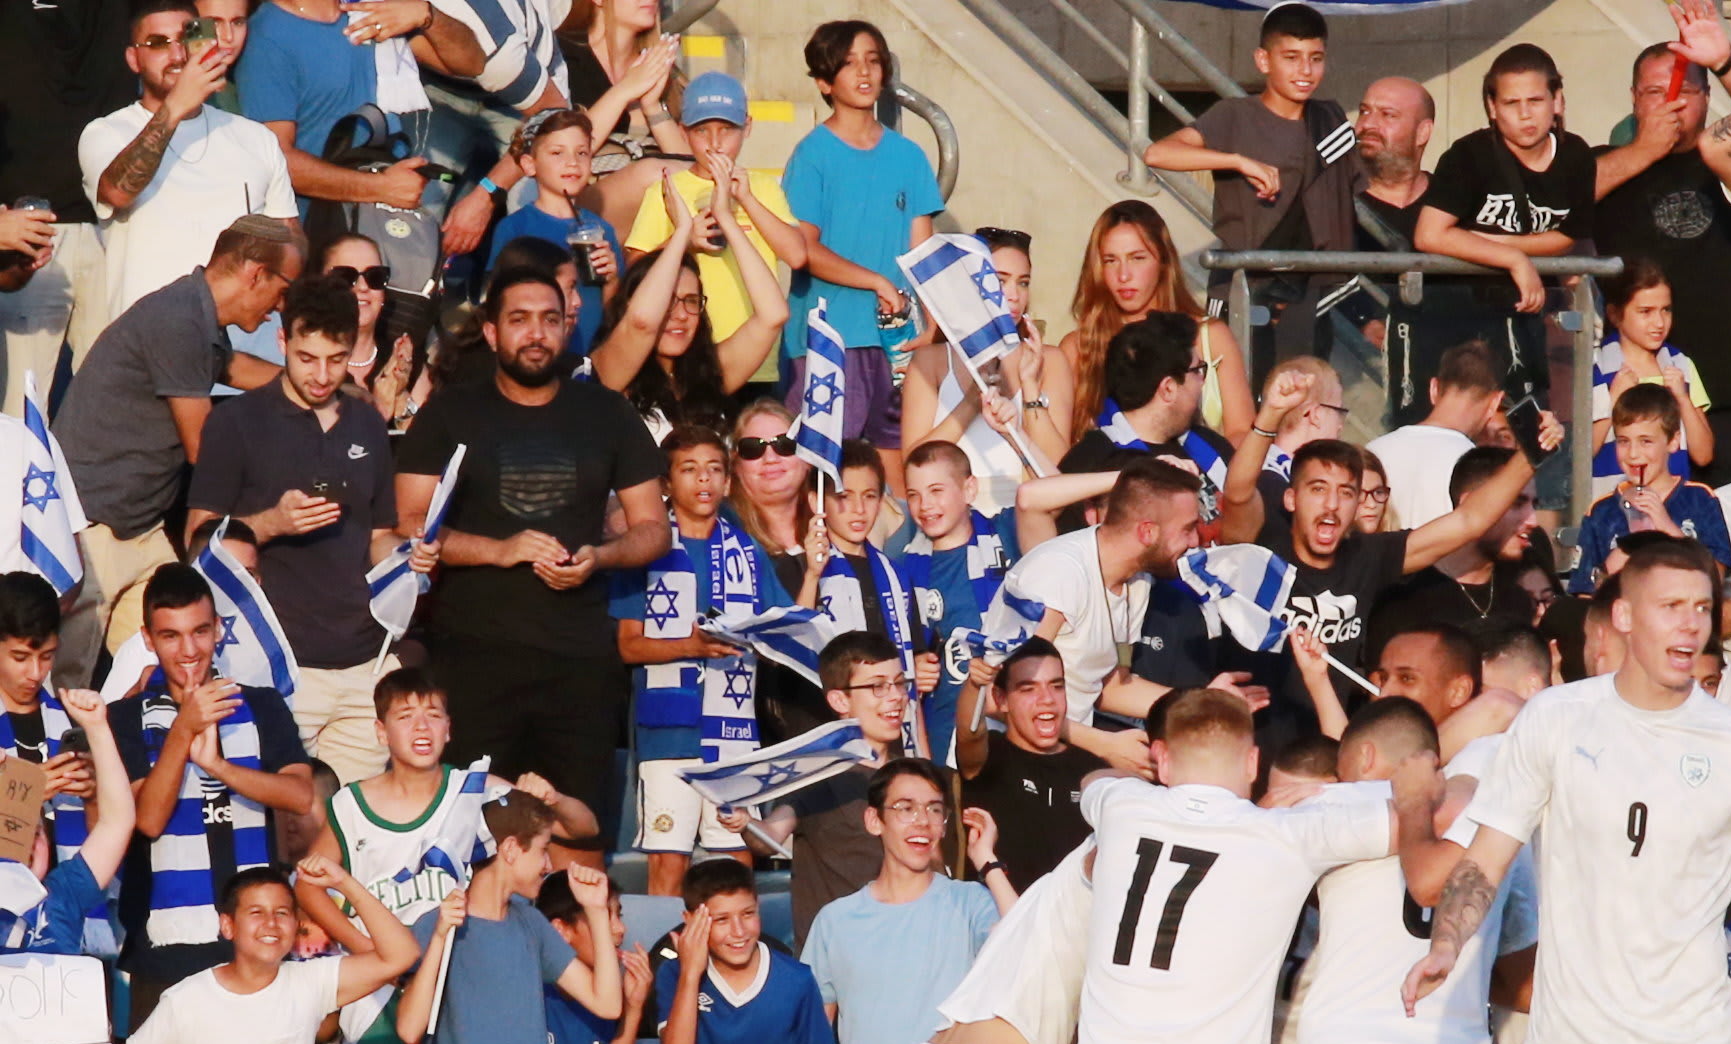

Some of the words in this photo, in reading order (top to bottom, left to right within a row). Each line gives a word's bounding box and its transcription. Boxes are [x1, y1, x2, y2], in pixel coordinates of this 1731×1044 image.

[1279, 608, 1362, 644] adidas
[722, 720, 752, 739] Israel
[1626, 801, 1650, 858] 9
[1111, 837, 1220, 972] 17
